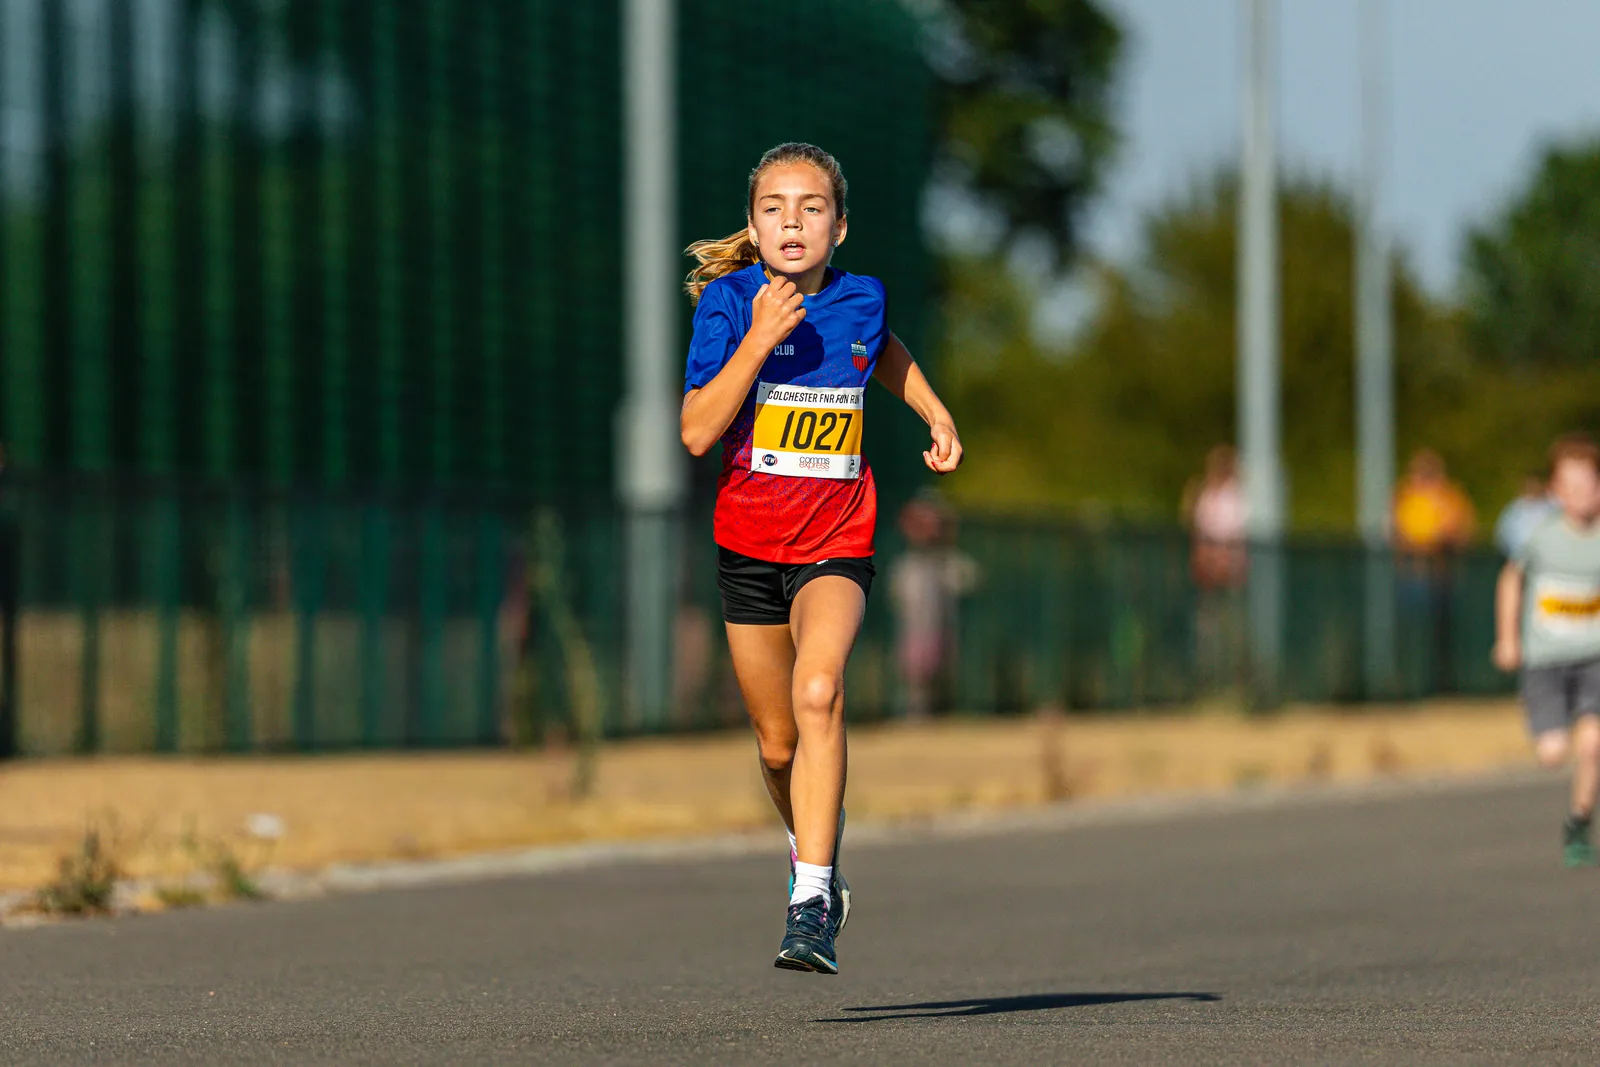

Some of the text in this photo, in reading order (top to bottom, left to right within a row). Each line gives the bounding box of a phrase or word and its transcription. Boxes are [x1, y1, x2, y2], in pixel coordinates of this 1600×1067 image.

[774, 344, 795, 356] CLUB
[767, 390, 818, 403] COLCHESTER
[819, 393, 835, 403] FNR
[779, 410, 853, 452] 1027
[799, 456, 830, 465] comms
[799, 462, 830, 470] express
